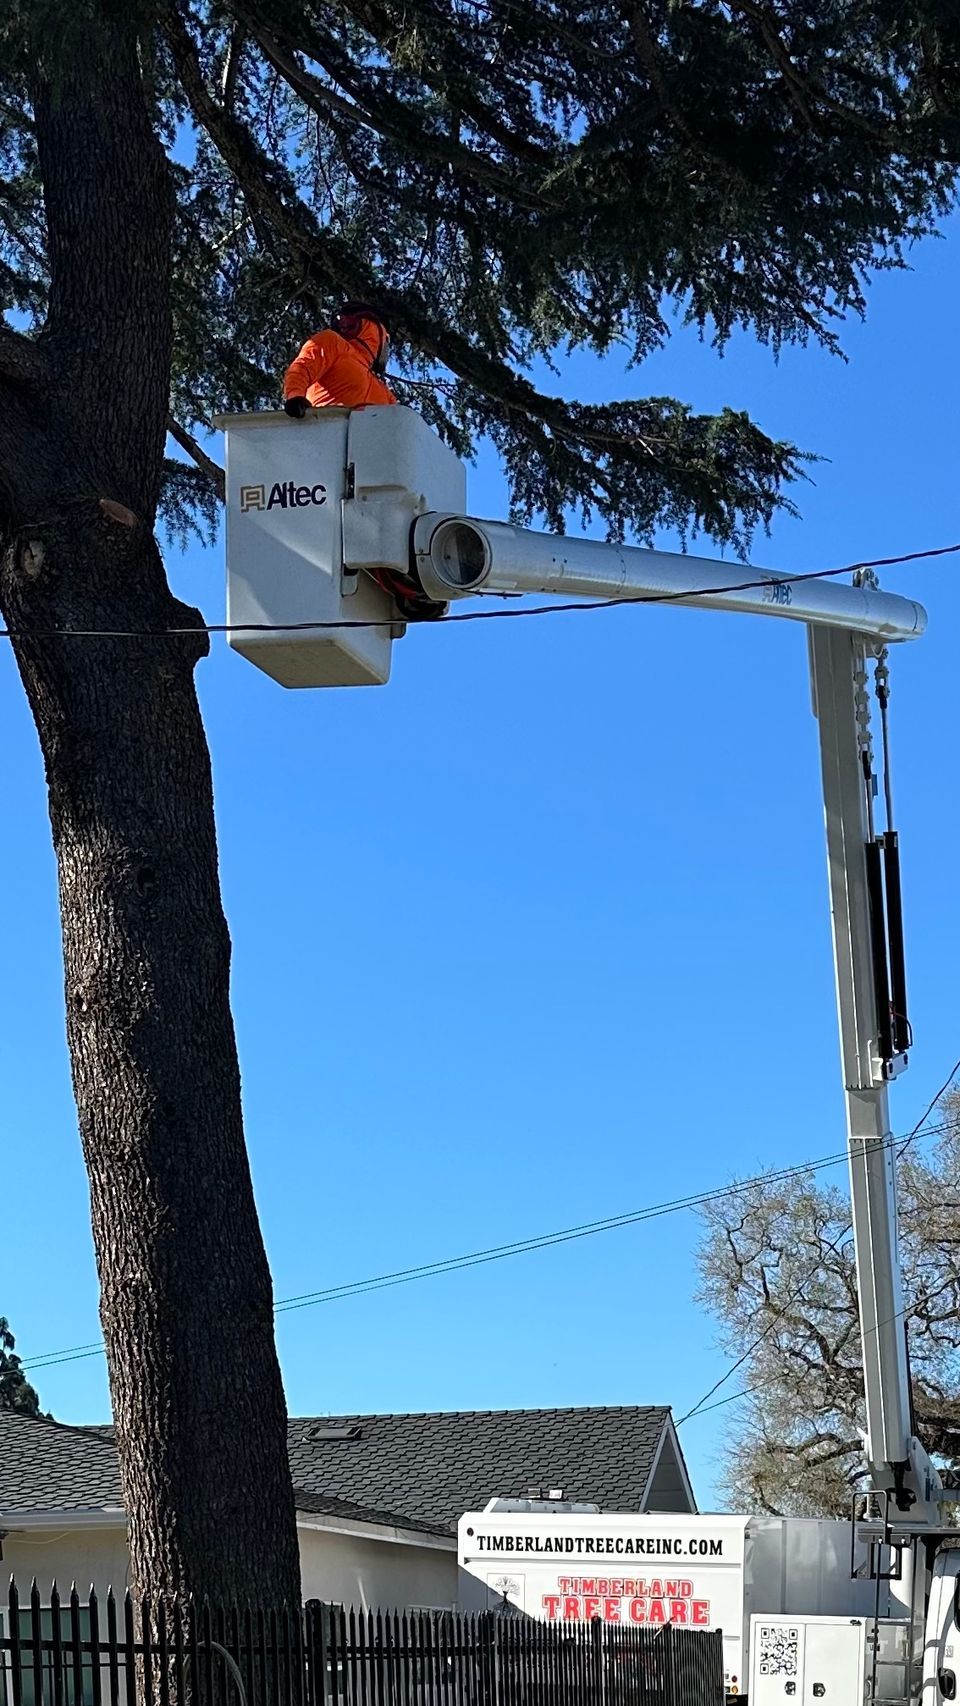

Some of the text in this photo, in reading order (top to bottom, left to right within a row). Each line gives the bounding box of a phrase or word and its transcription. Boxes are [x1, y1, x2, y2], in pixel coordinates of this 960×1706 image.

[266, 481, 327, 510] Altec
[477, 1535, 723, 1556] TIMBERLANDTREECAREINC.COM
[558, 1576, 694, 1599] TIMBERLAND
[542, 1595, 710, 1626] TREE CARE
